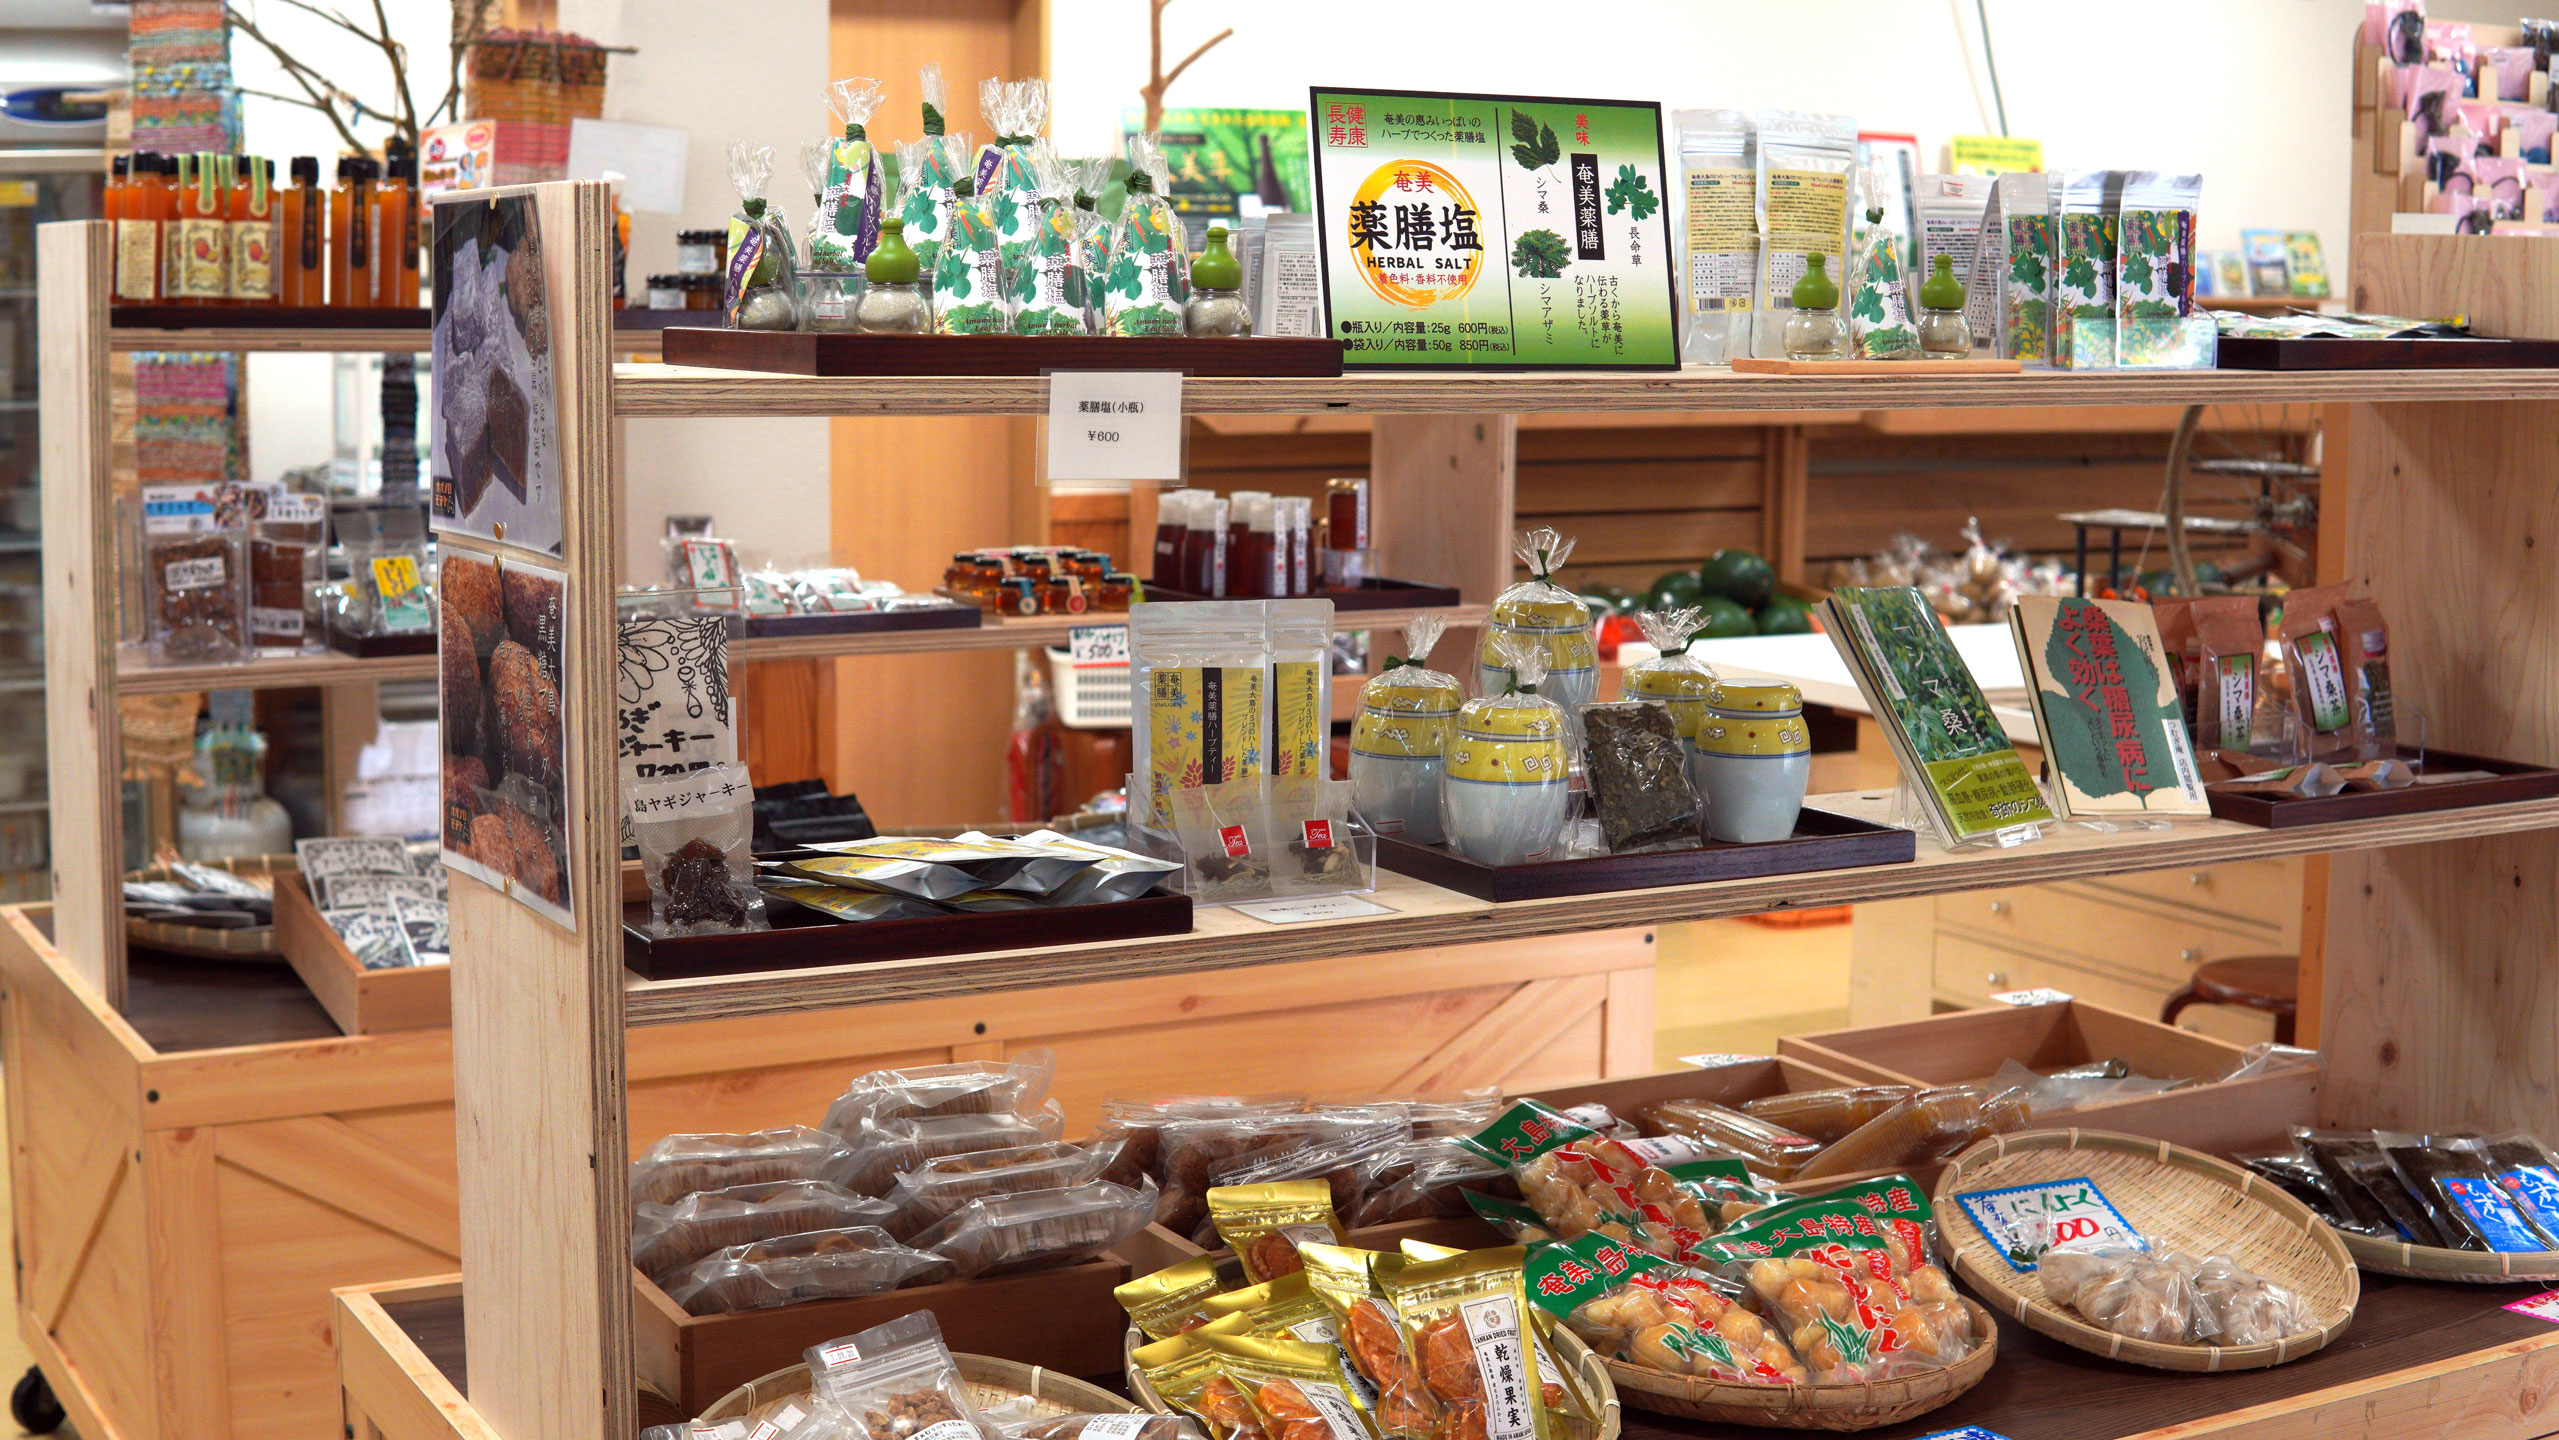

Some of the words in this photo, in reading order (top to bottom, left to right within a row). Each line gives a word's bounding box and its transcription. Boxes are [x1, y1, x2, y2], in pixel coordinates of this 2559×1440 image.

[1328, 105, 1347, 146] 長寿
[1347, 105, 1367, 146] 健康
[1381, 128, 1486, 144] ハーブでつくった薬膳塩
[1383, 112, 1481, 128] 奄美の恵みいっぱいの
[1575, 113, 1590, 146] 美味
[1393, 169, 1435, 194] 奄美
[1536, 177, 1550, 215] シマ桑
[1349, 200, 1484, 252] 薬膳塩
[1576, 162, 1599, 251] 奄美薬膳
[1367, 256, 1424, 270] HERBAL
[1435, 258, 1473, 270] SALT
[1629, 227, 1642, 267] 長命草
[979, 250, 1000, 300] 薬膳塩
[1046, 254, 1066, 304] 薬膳塩
[1150, 252, 1171, 300] 薬膳塩
[1378, 272, 1468, 287] 着色料・香料不使用
[1540, 283, 1555, 346] シマアザミ
[1575, 275, 1588, 335] なりました。
[1586, 275, 1601, 349] ハーブソルトに
[1597, 276, 1612, 345] 伝わる薬草が
[1608, 276, 1624, 356] 古くから奄美に
[1078, 400, 1144, 414] 薬膳塩(小瓶)
[1088, 431, 1120, 442] ¥600
[2058, 605, 2102, 713] よく効く
[1157, 673, 1168, 698] 薬膳
[1169, 673, 1181, 698] 奄美
[2083, 605, 2153, 792] 桑葉は糖尿病に
[2314, 649, 2342, 717] シマ桑茶
[1206, 681, 1218, 773] 奄美薬膳ハーブティー
[2232, 671, 2246, 742] シマ桑茶
[635, 782, 748, 814] 島ヤギジャーキー
[1227, 835, 1244, 850] Tea
[1310, 827, 1328, 841] Tea
[1475, 1333, 1493, 1344] TANKAN
[1493, 1331, 1505, 1341] DRIED
[1506, 1329, 1517, 1338] FRUIT
[1494, 1343, 1521, 1428] 乾燥果実
